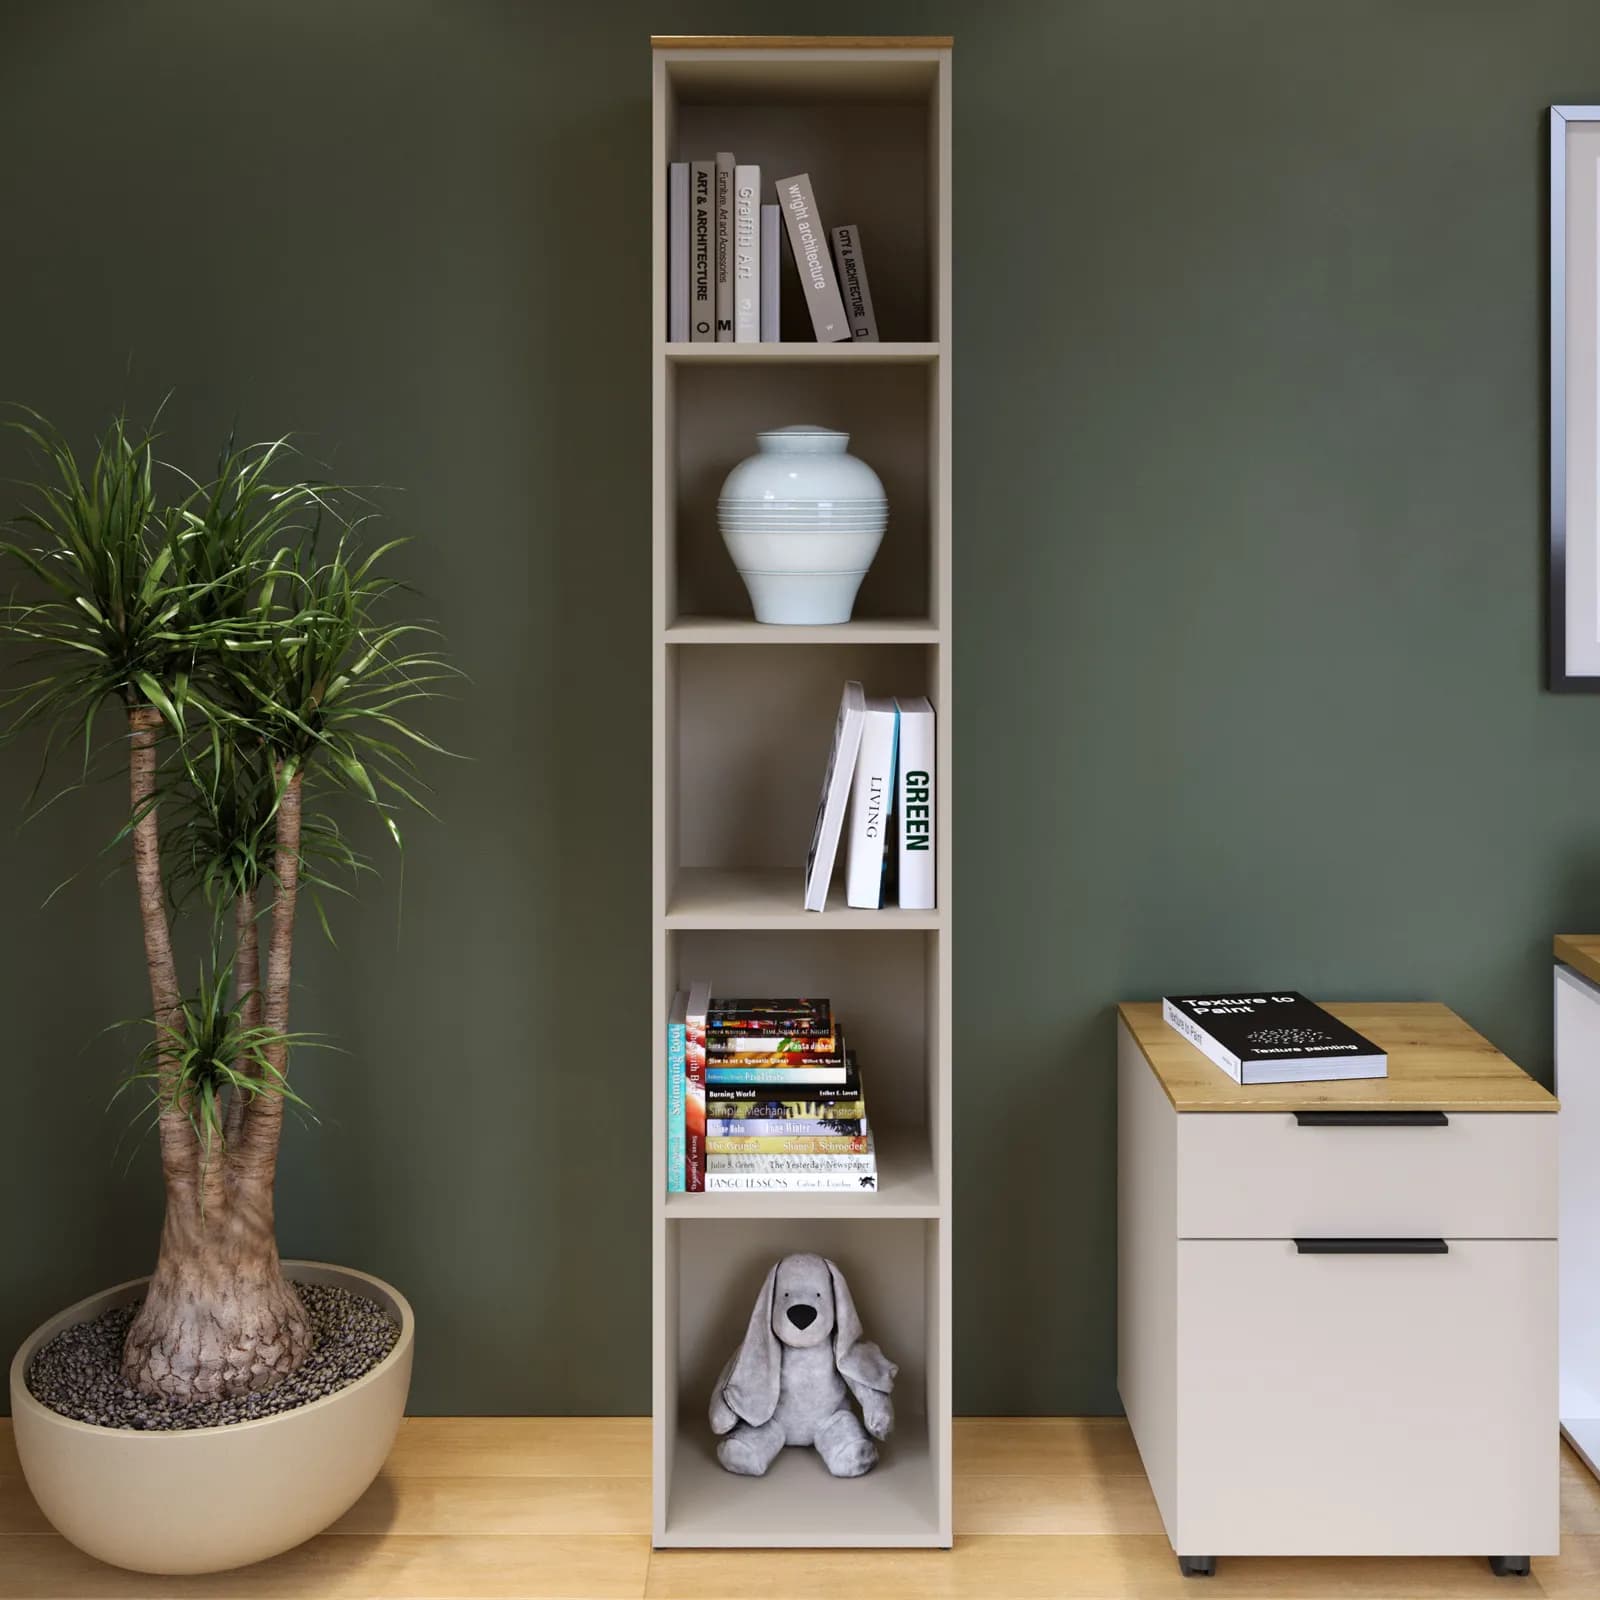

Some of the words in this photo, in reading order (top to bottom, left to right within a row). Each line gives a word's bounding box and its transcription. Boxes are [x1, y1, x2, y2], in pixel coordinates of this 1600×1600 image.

[697, 171, 708, 196] ART
[697, 196, 708, 205] &
[719, 209, 729, 223] Art
[738, 187, 753, 248] Graffiti
[719, 224, 729, 237] and
[788, 184, 808, 221] wright
[798, 221, 825, 290] architecture
[839, 230, 851, 248] CITY
[697, 210, 708, 301] ARCHITECTURE
[719, 237, 729, 283] Accessories
[841, 247, 853, 257] &
[738, 256, 753, 280] Art
[844, 257, 866, 317] ARCHITECTURE
[718, 320, 731, 331] M
[866, 776, 882, 839] LIVING
[906, 770, 930, 851] GREEN
[1182, 997, 1268, 1008] Texture
[1192, 1005, 1256, 1016] Paint
[672, 1028, 683, 1053] Pool
[1251, 1046, 1302, 1055] Texture
[1304, 1044, 1359, 1053] painting
[690, 1053, 700, 1072] with
[671, 1057, 684, 1116] Swimming
[709, 1090, 735, 1099] Burning
[820, 1141, 864, 1150] Schroeder
[769, 1160, 785, 1169] The
[786, 1160, 824, 1170] Yesterday
[826, 1160, 870, 1171] Newspaper
[710, 1178, 743, 1188] TANGO
[745, 1178, 788, 1188] LESSONS
